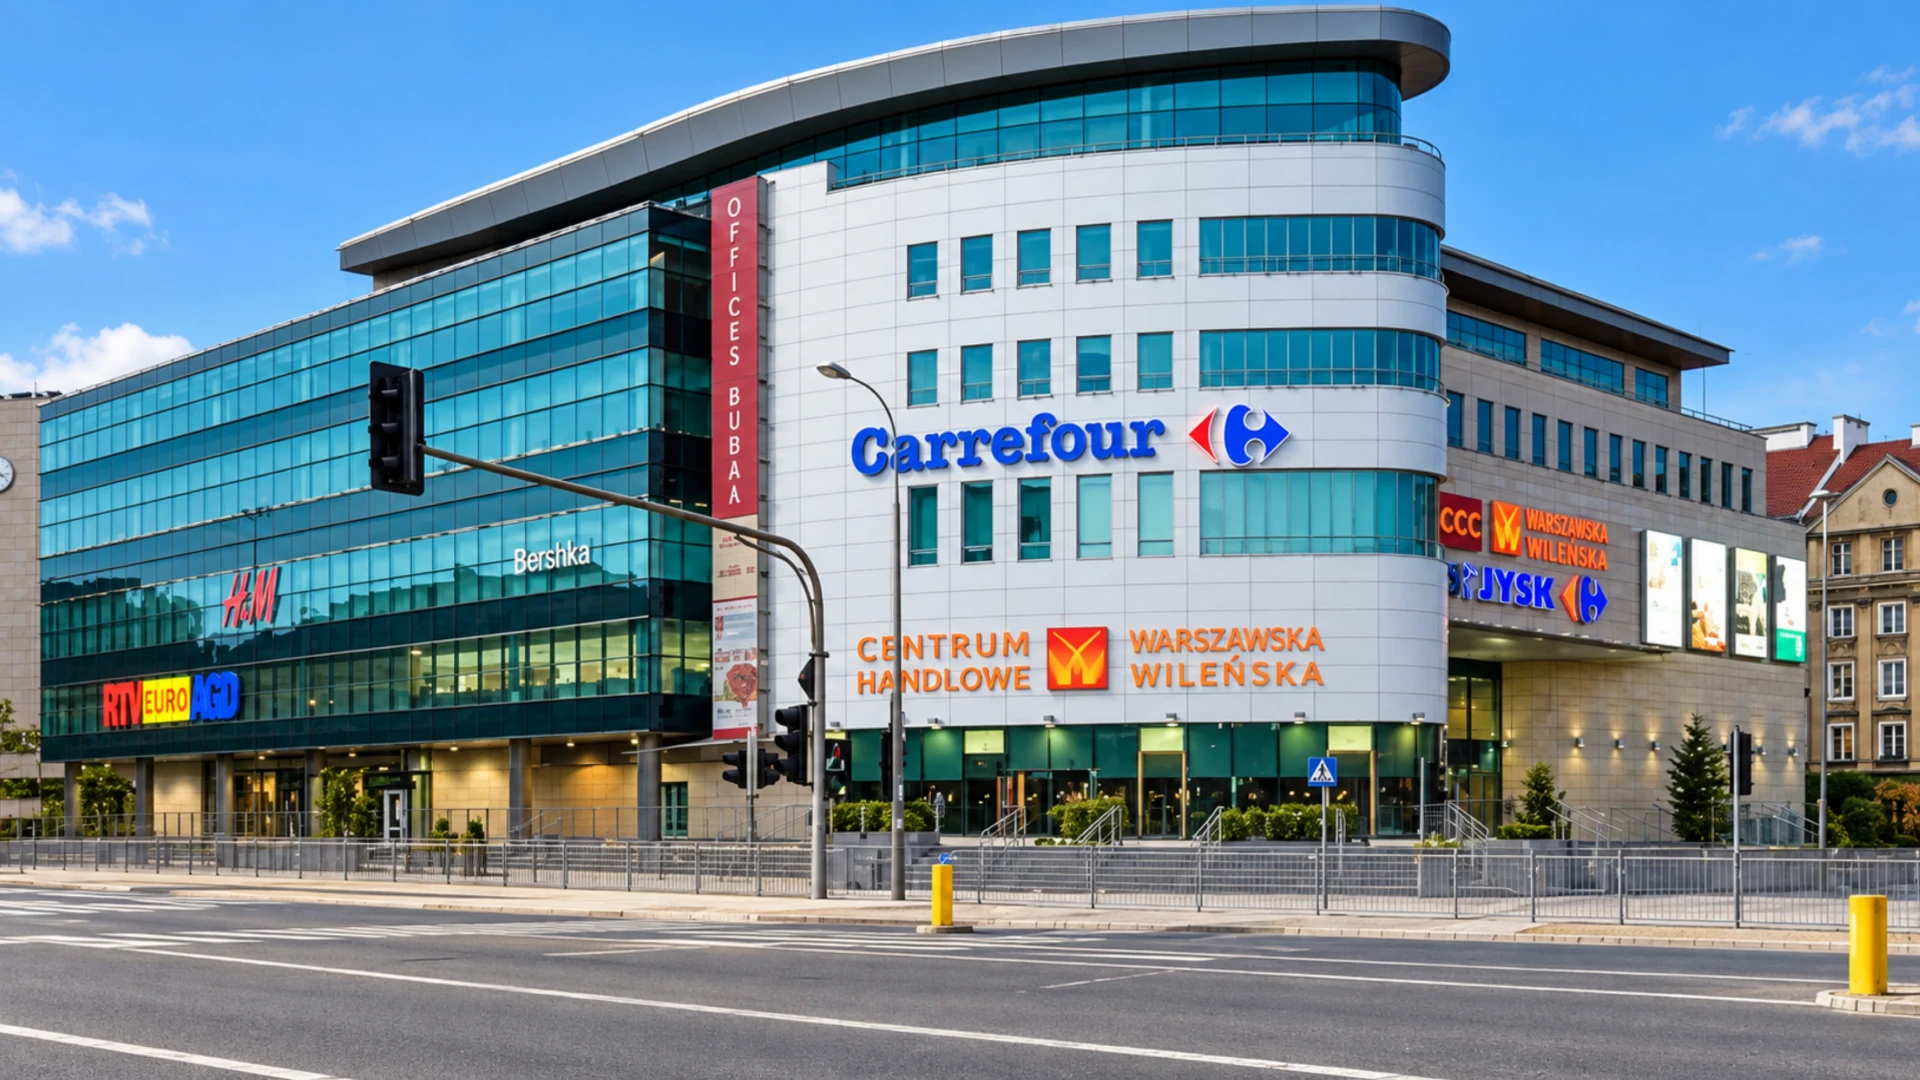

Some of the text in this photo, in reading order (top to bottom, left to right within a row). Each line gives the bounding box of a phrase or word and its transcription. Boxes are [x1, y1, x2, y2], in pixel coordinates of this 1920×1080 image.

[727, 197, 742, 366] OFFICES
[728, 387, 741, 505] BUBAA
[851, 412, 1165, 476] Carrefour
[1439, 506, 1482, 539] CCC
[1525, 507, 1609, 545] WARSZAWSKA
[514, 540, 591, 576] Bershka
[1525, 535, 1609, 572] WILEŃSKA
[221, 566, 279, 629] H&M
[1478, 566, 1555, 610] JYSK
[857, 631, 1030, 663] CENTRUM
[1129, 626, 1326, 654] WARSZAWSKA
[857, 665, 1031, 695] HANDLOWE
[1130, 654, 1325, 688] WILEŃSKA
[102, 670, 240, 728] RTV EURO AGD
